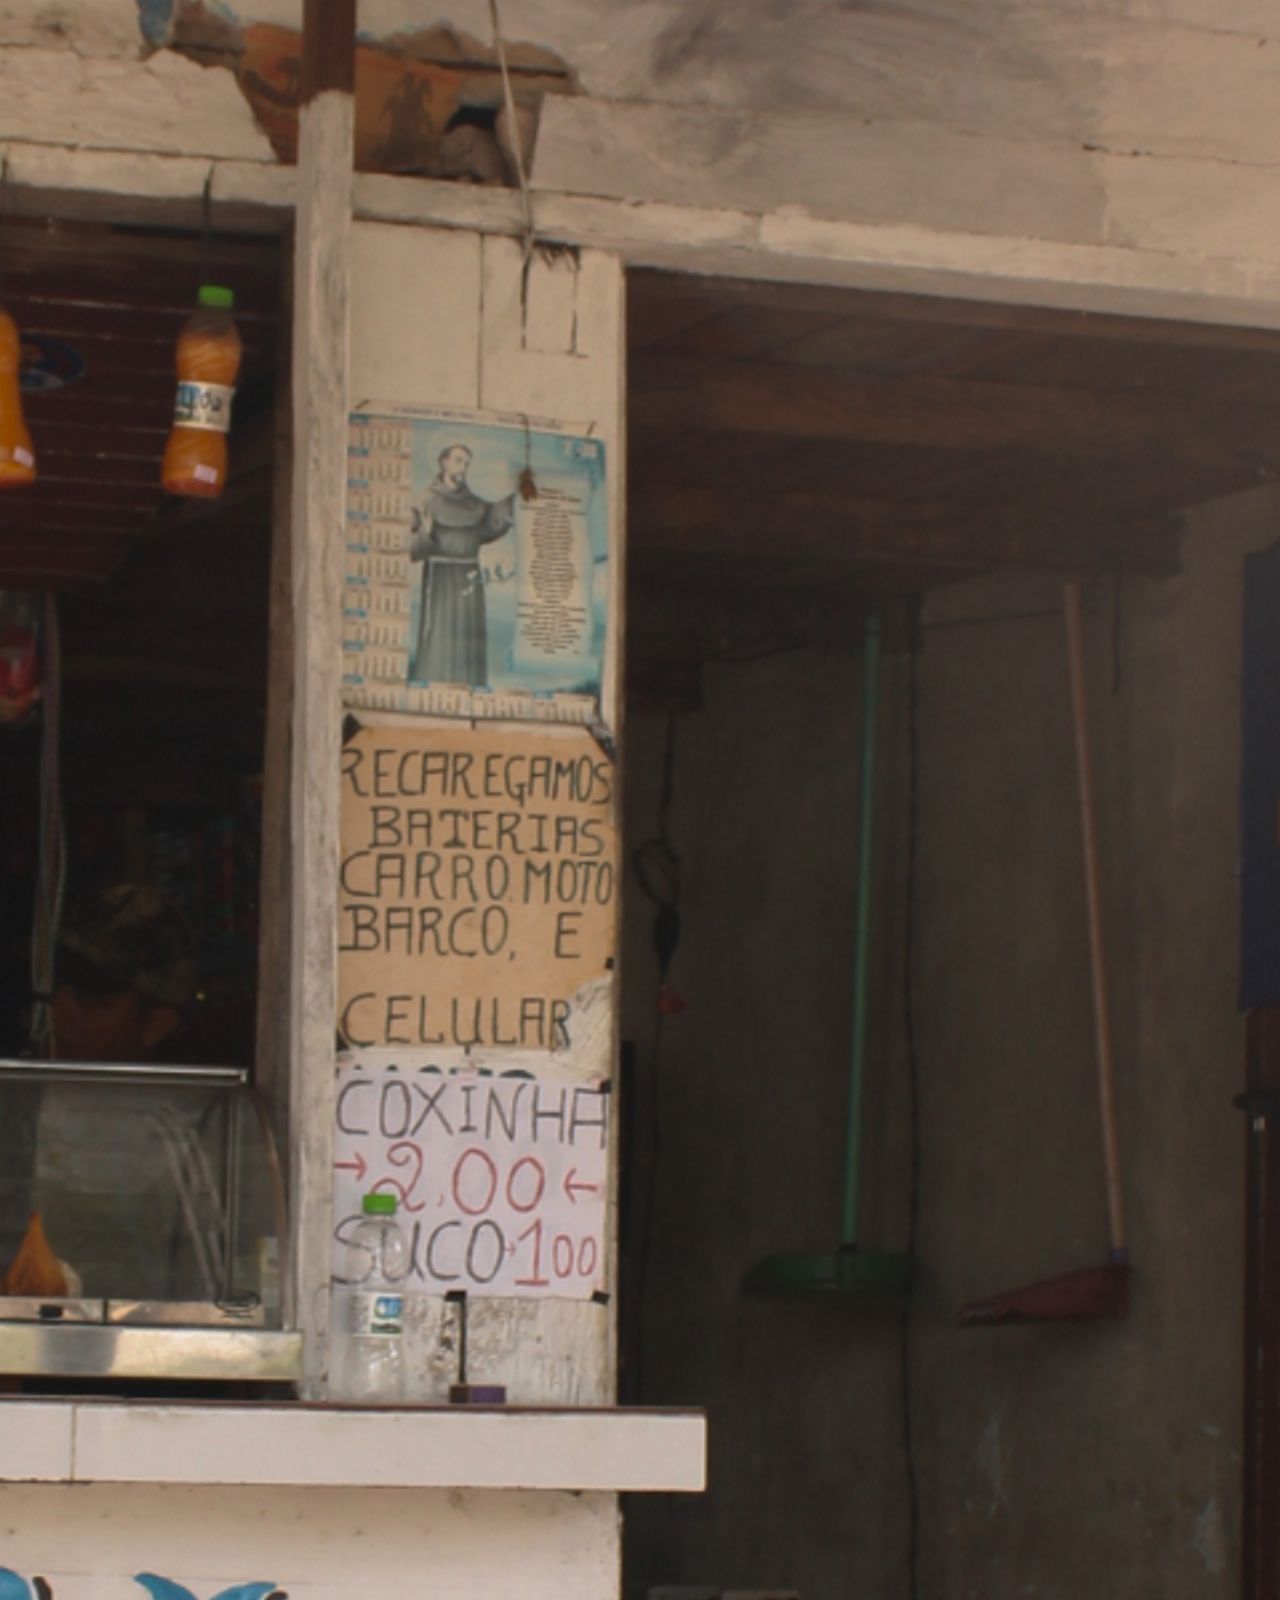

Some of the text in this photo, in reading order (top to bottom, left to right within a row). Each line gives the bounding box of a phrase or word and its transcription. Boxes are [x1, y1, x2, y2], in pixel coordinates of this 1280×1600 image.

[368, 805, 605, 857] BATERIAS
[523, 859, 613, 904] MOTO
[338, 905, 583, 960] BARCO, E
[340, 992, 571, 1051] CELULAR
[336, 1079, 609, 1149] COXINHA
[331, 1214, 506, 1284] SUCO
